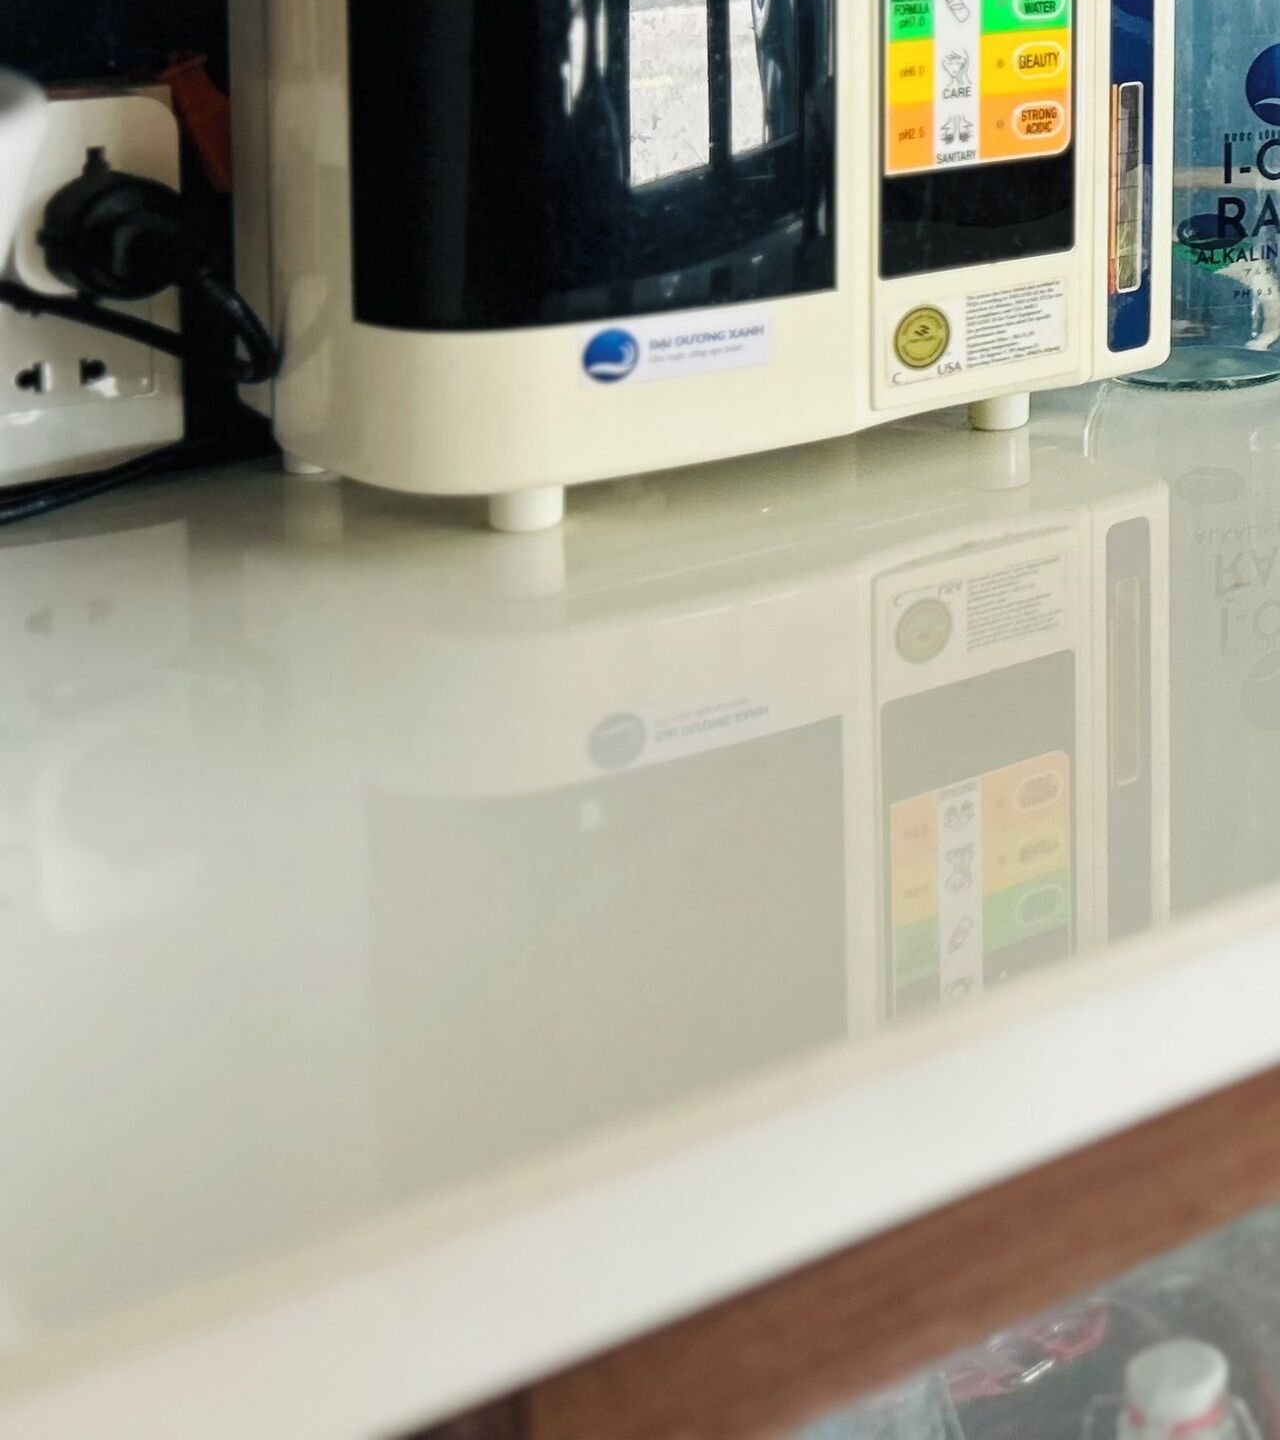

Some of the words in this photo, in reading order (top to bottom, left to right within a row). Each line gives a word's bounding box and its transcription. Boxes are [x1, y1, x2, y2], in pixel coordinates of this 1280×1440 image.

[1023, 1, 1056, 15] WATER
[1018, 51, 1060, 70] BEAUTY
[942, 86, 972, 100] CARE
[1020, 107, 1058, 123] STRONG
[1025, 121, 1054, 135] ACIDIC
[936, 149, 977, 165] SANITARY
[728, 324, 765, 340] XANH
[937, 361, 962, 375] USA
